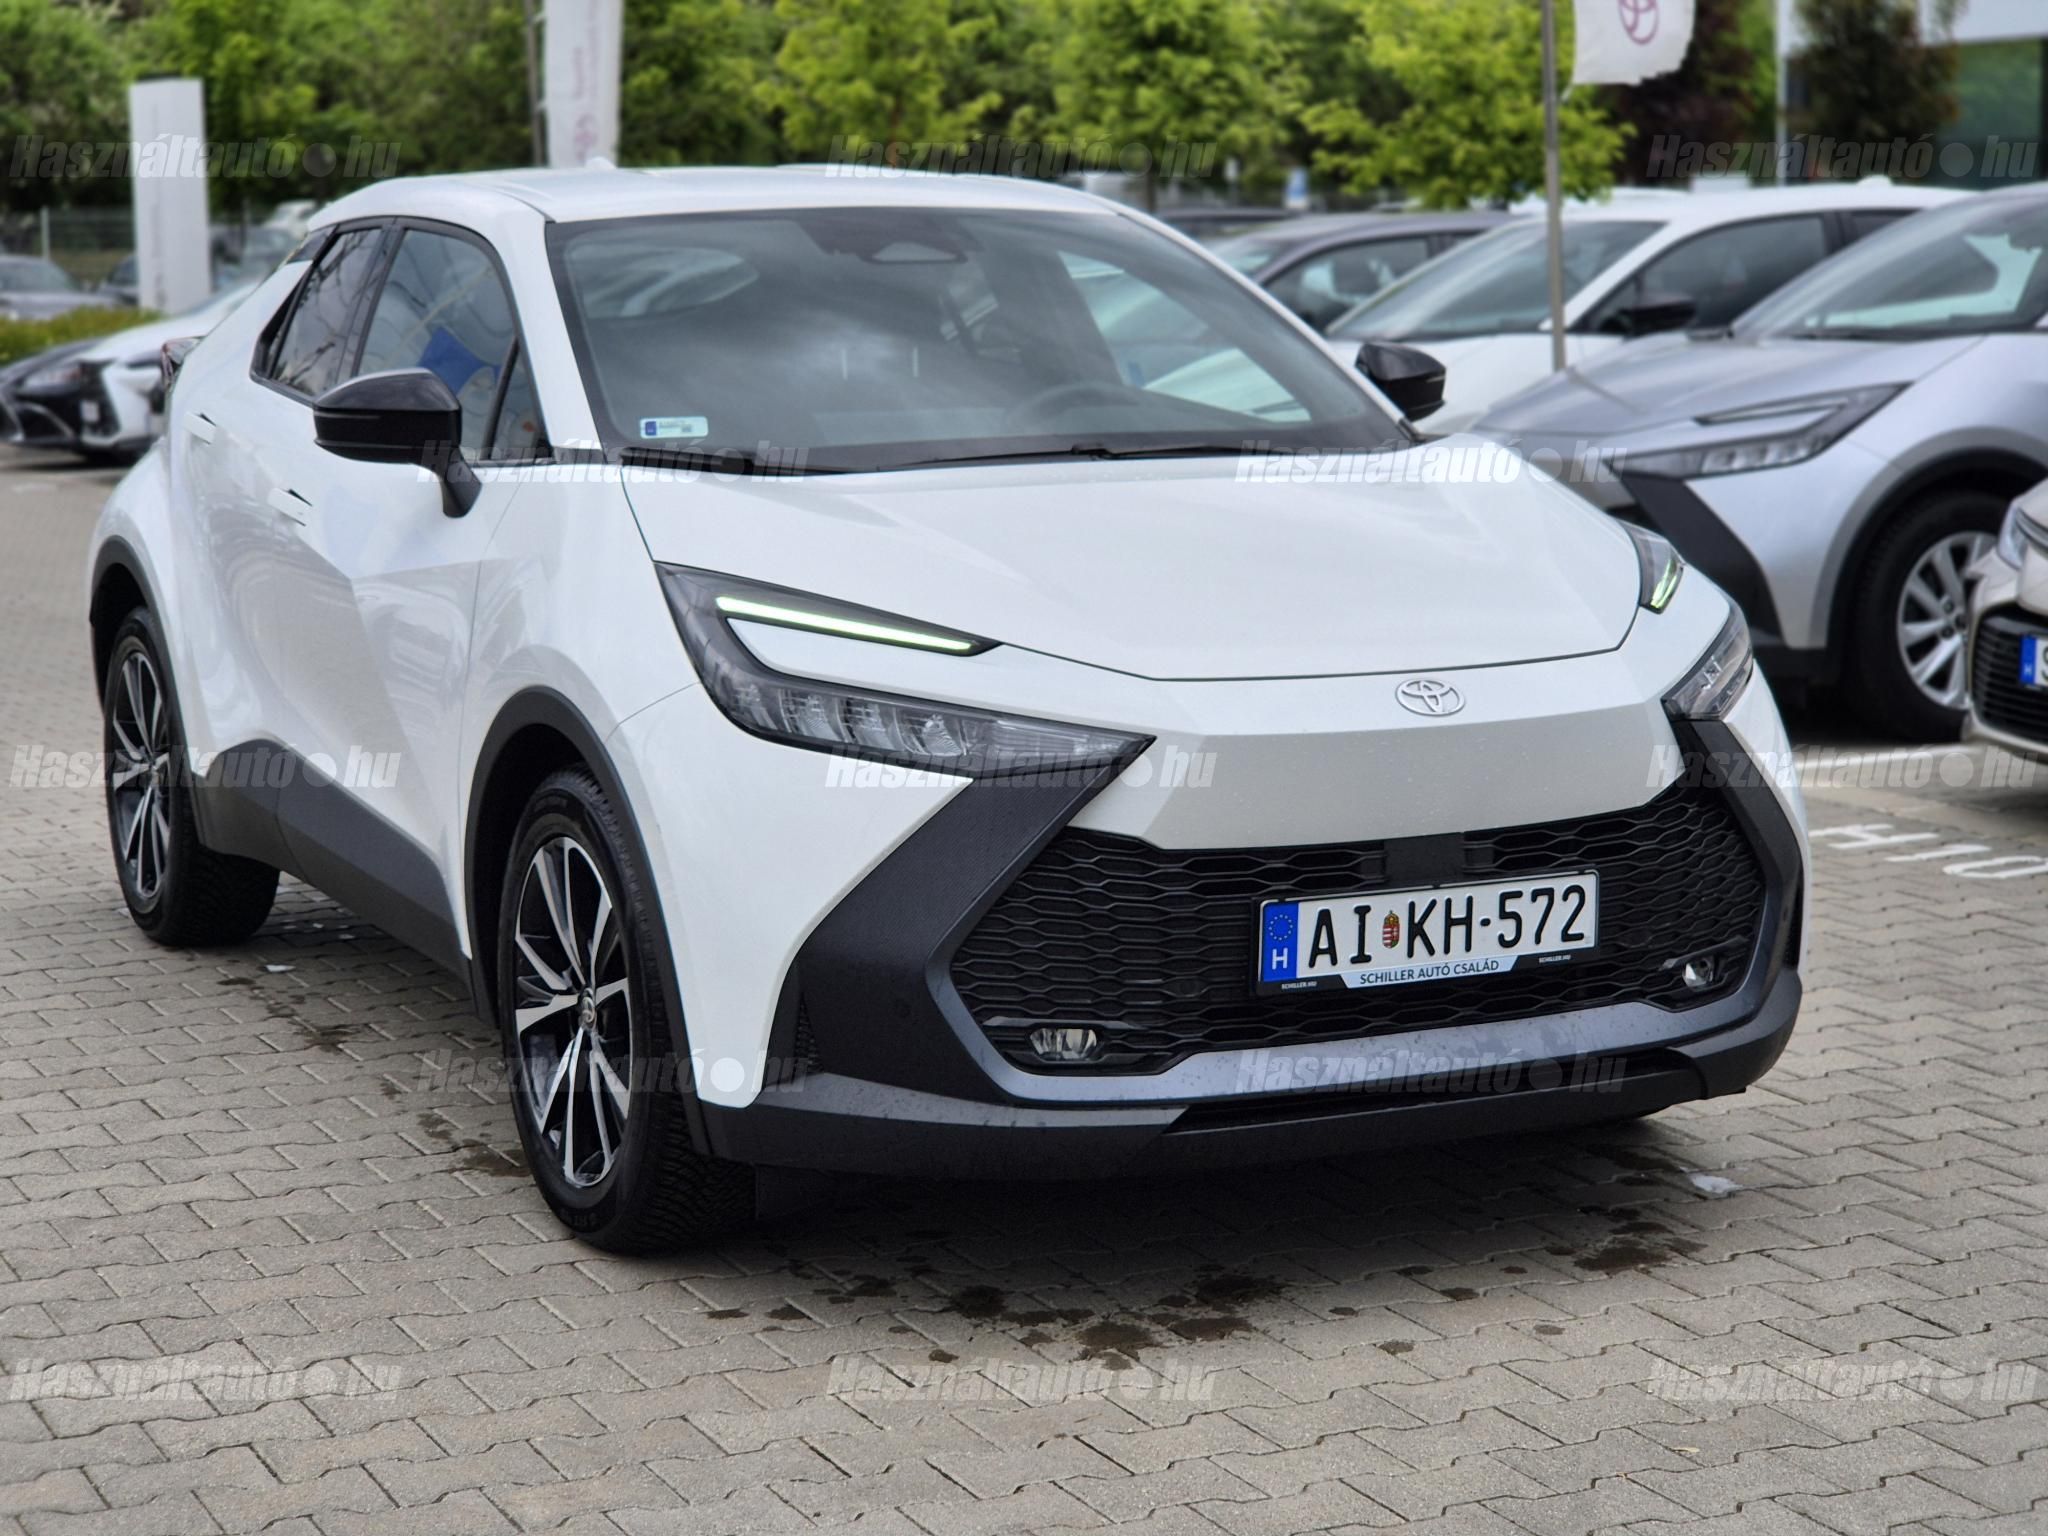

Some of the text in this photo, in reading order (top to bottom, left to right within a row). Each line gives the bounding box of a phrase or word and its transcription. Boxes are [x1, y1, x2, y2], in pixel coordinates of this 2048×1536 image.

[1272, 884, 1587, 970] H AI KH-572
[1360, 957, 1500, 986] SCHILLER AUTÓ CSALÁD
